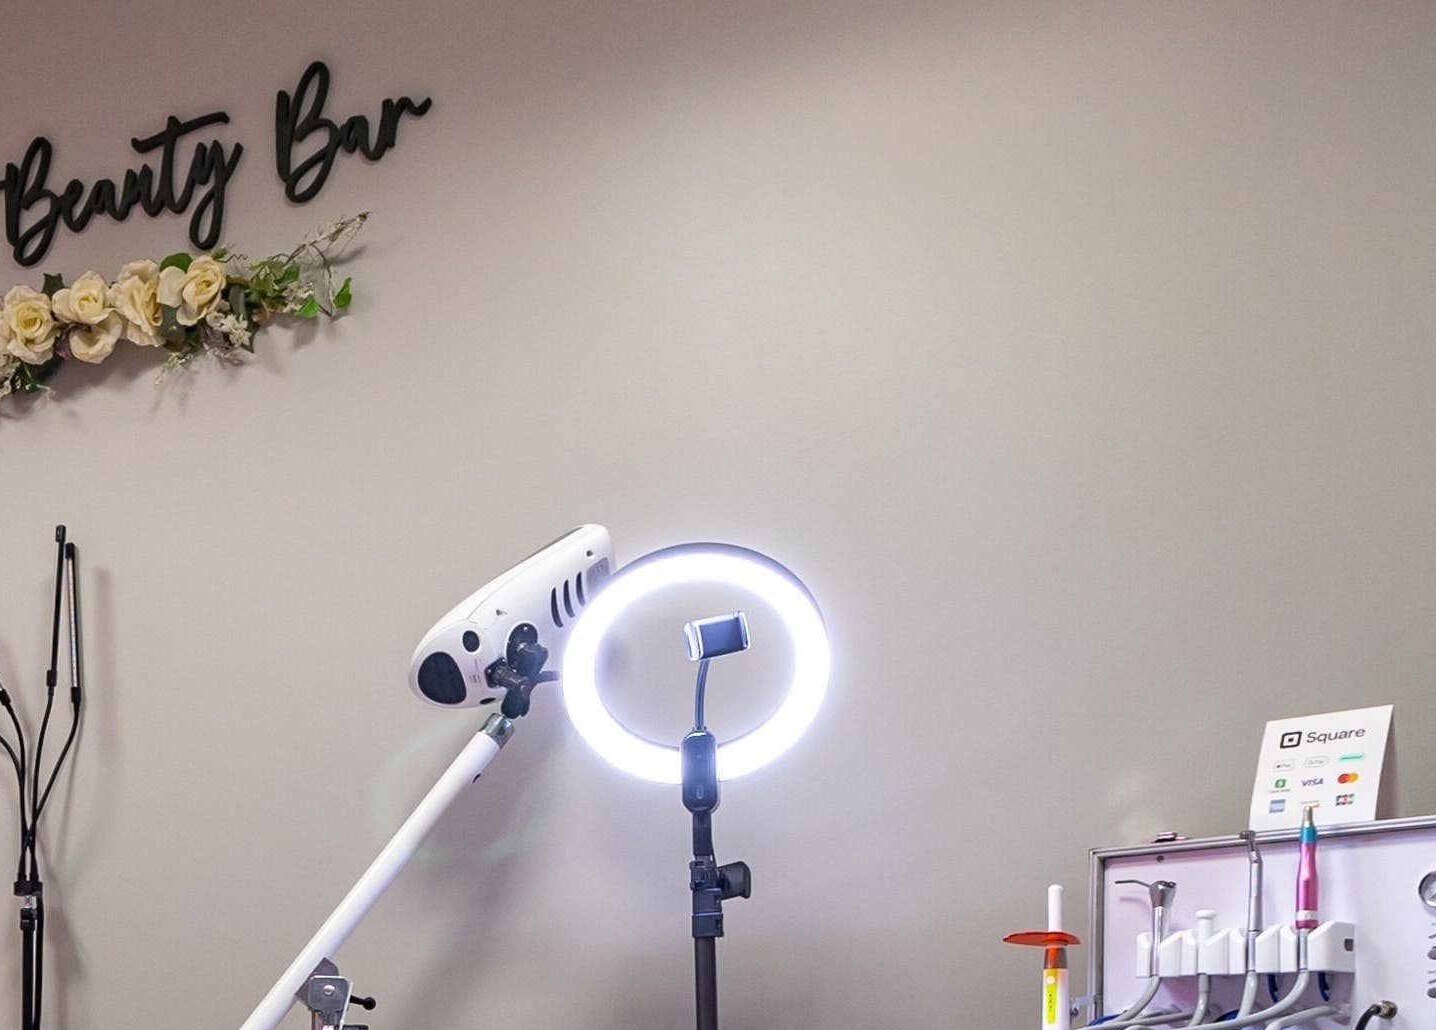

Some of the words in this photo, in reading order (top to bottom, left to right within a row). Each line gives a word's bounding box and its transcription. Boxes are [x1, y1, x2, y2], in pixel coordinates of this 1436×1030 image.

[4, 111, 244, 266] Beauty
[274, 60, 432, 203] Bar
[1305, 727, 1366, 744] Square
[1301, 778, 1324, 787] VISA
